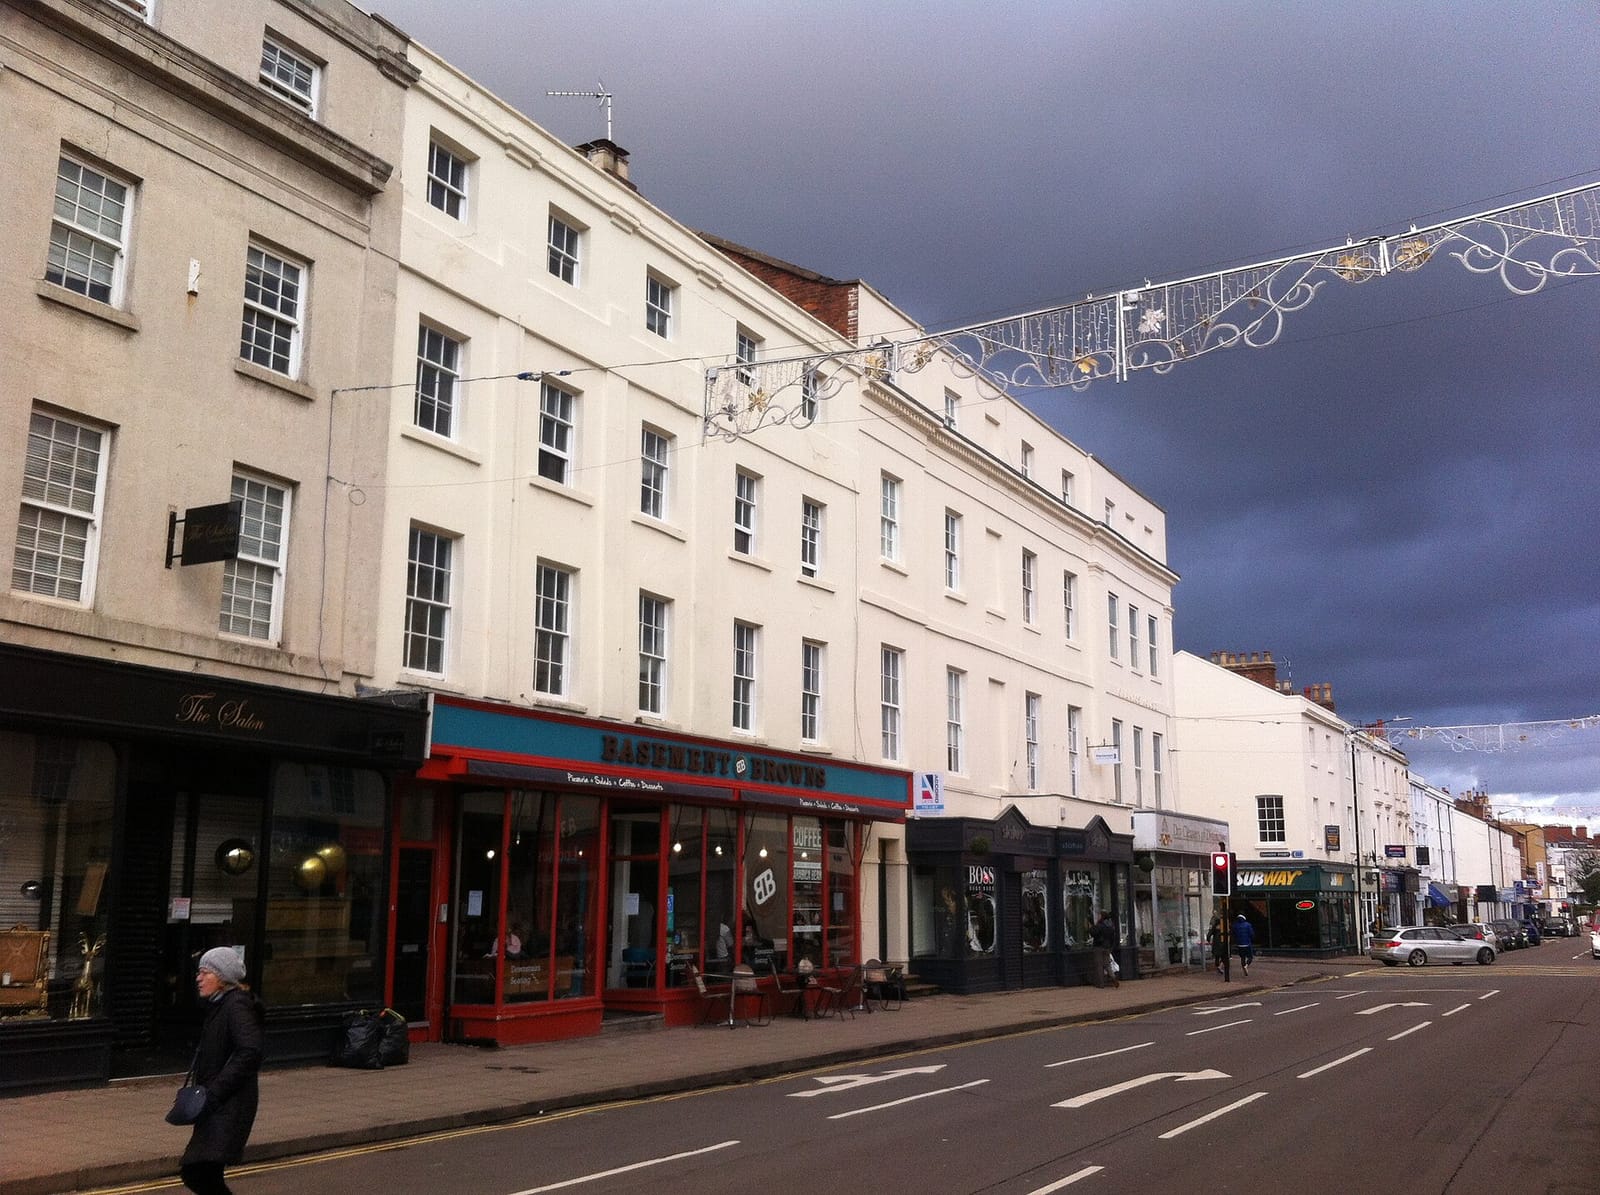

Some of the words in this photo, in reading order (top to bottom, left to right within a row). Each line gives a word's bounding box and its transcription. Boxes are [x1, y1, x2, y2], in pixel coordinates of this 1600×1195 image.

[176, 692, 216, 721] The
[217, 699, 264, 730] Salon
[602, 735, 731, 774] BASEMENT
[751, 758, 826, 788] BROWNS
[594, 775, 612, 786] Salads
[618, 778, 636, 788] Coffee
[640, 780, 664, 791] Desserts
[793, 825, 822, 847] COFFEE
[969, 865, 995, 885] BOSS
[1236, 870, 1304, 887] SUBWAY
